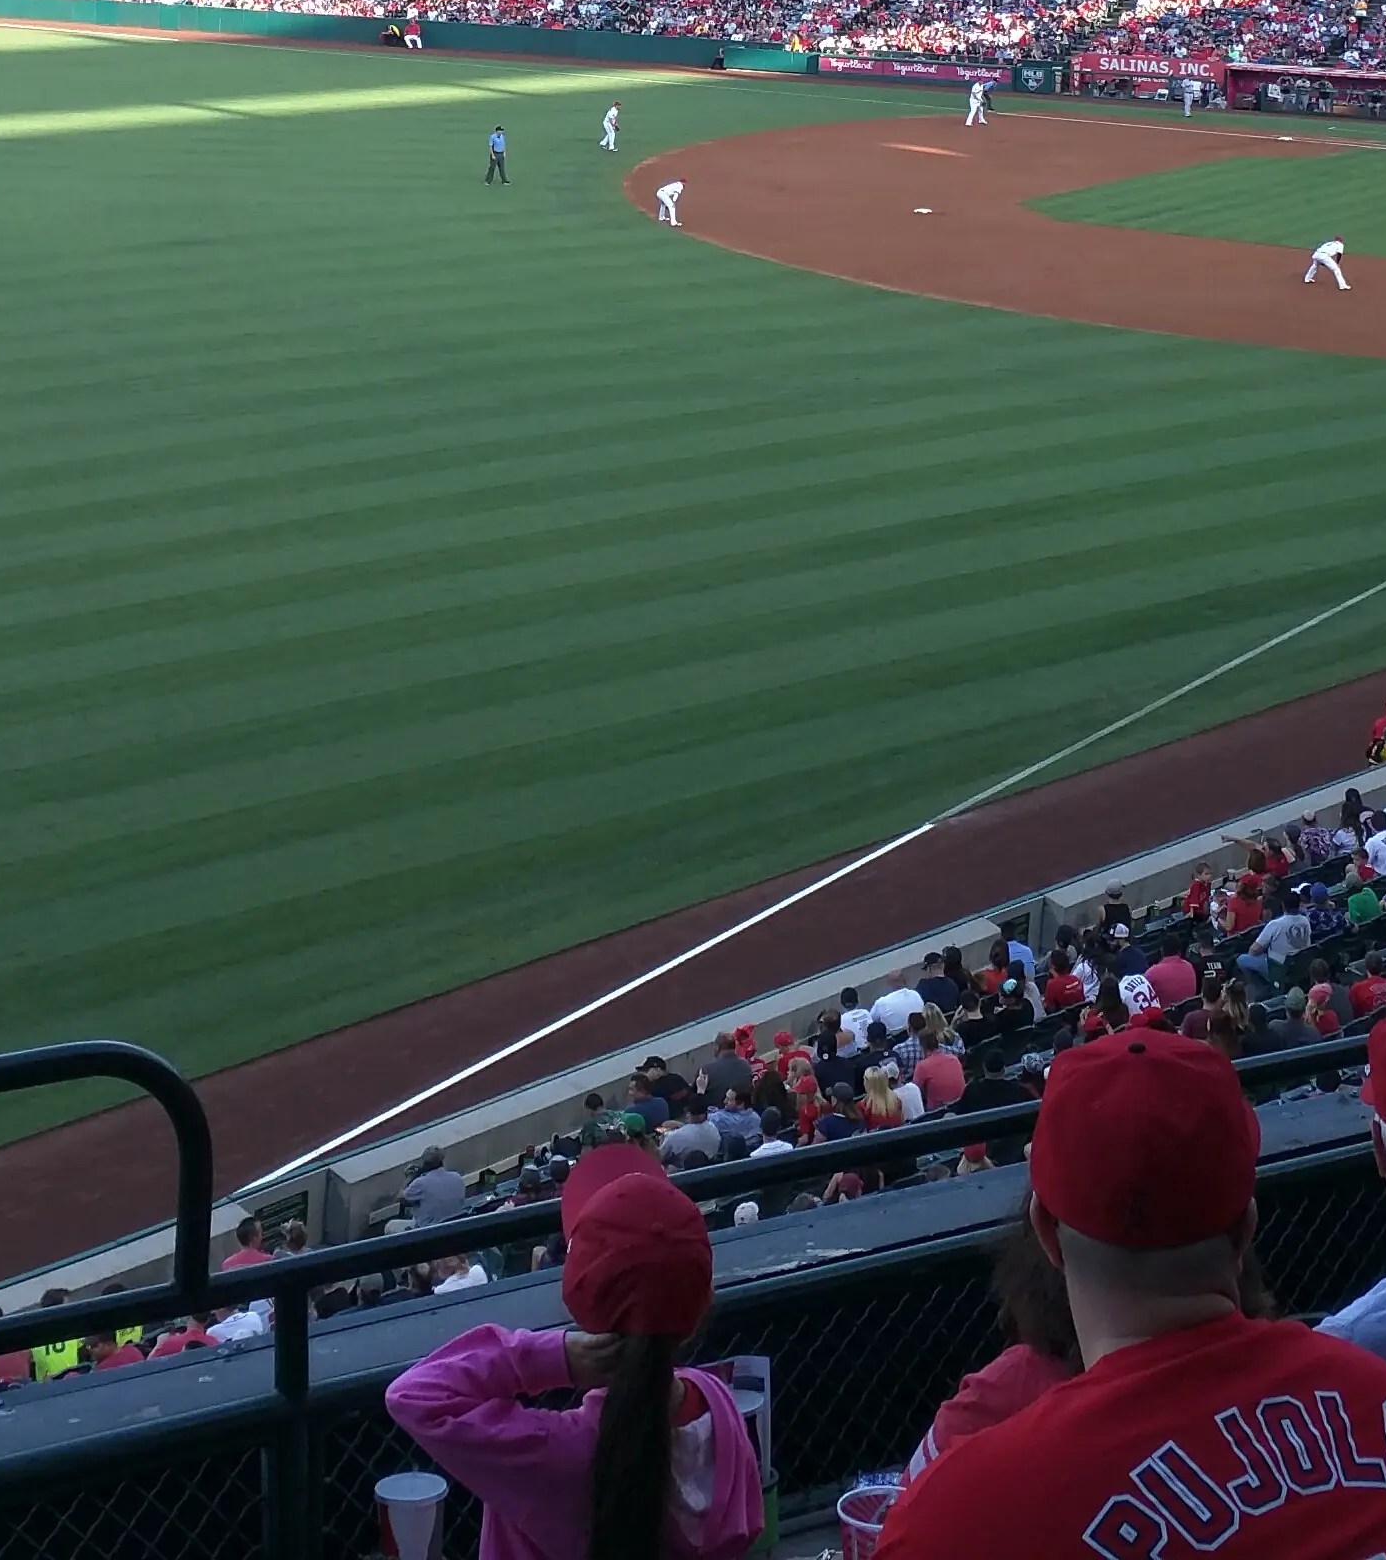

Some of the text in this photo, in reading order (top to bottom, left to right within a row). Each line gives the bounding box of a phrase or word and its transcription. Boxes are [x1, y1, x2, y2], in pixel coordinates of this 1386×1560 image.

[828, 58, 874, 72] Yogurtland
[892, 61, 937, 76] Yogurtland
[1099, 57, 1173, 76] SALINAS,
[1179, 62, 1214, 77] INC.
[956, 67, 1001, 81] Yogurtland
[1206, 961, 1223, 971] TEAM
[1124, 976, 1146, 993] ORTIZ
[1132, 985, 1159, 1011] 34
